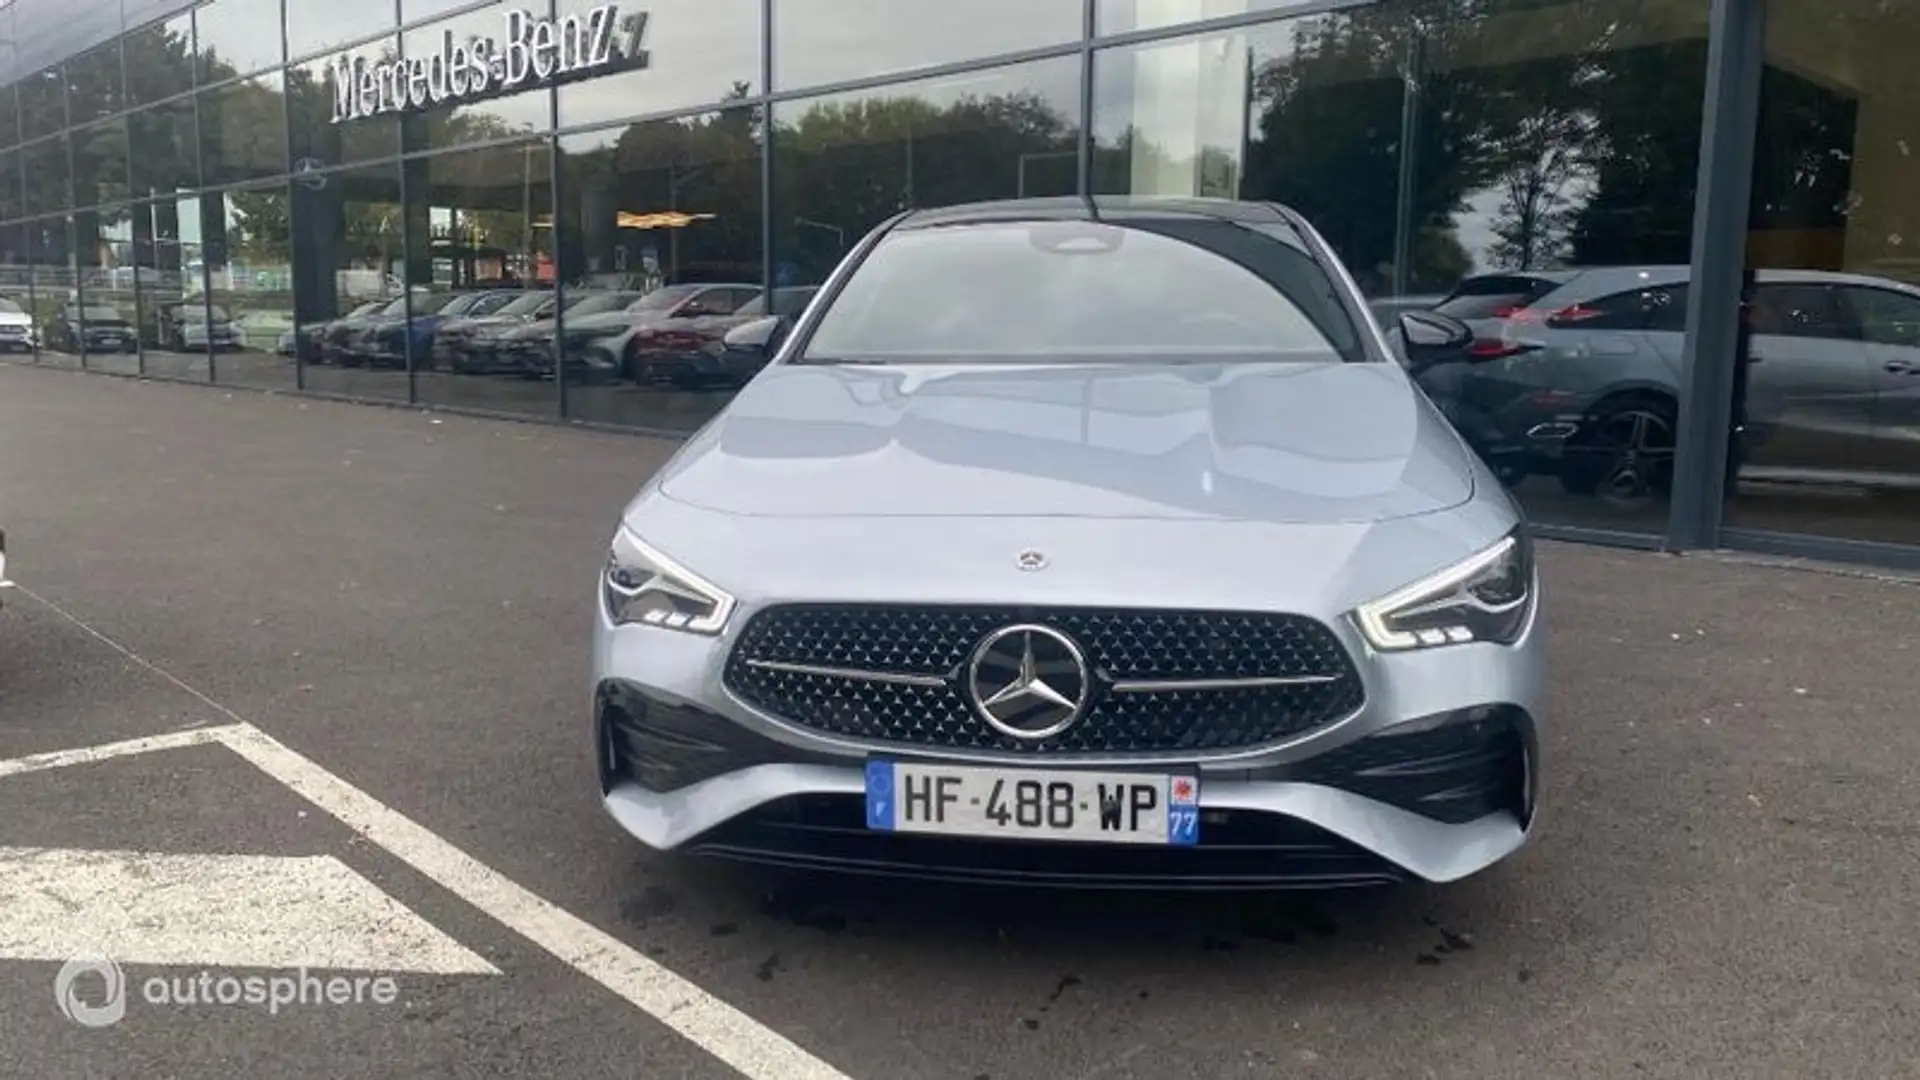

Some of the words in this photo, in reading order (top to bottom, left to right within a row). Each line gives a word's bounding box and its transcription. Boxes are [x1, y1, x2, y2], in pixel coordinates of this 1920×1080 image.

[329, 4, 613, 124] Mercedes-Benz
[904, 773, 1158, 832] HF-488-WP
[1170, 811, 1197, 835] 77
